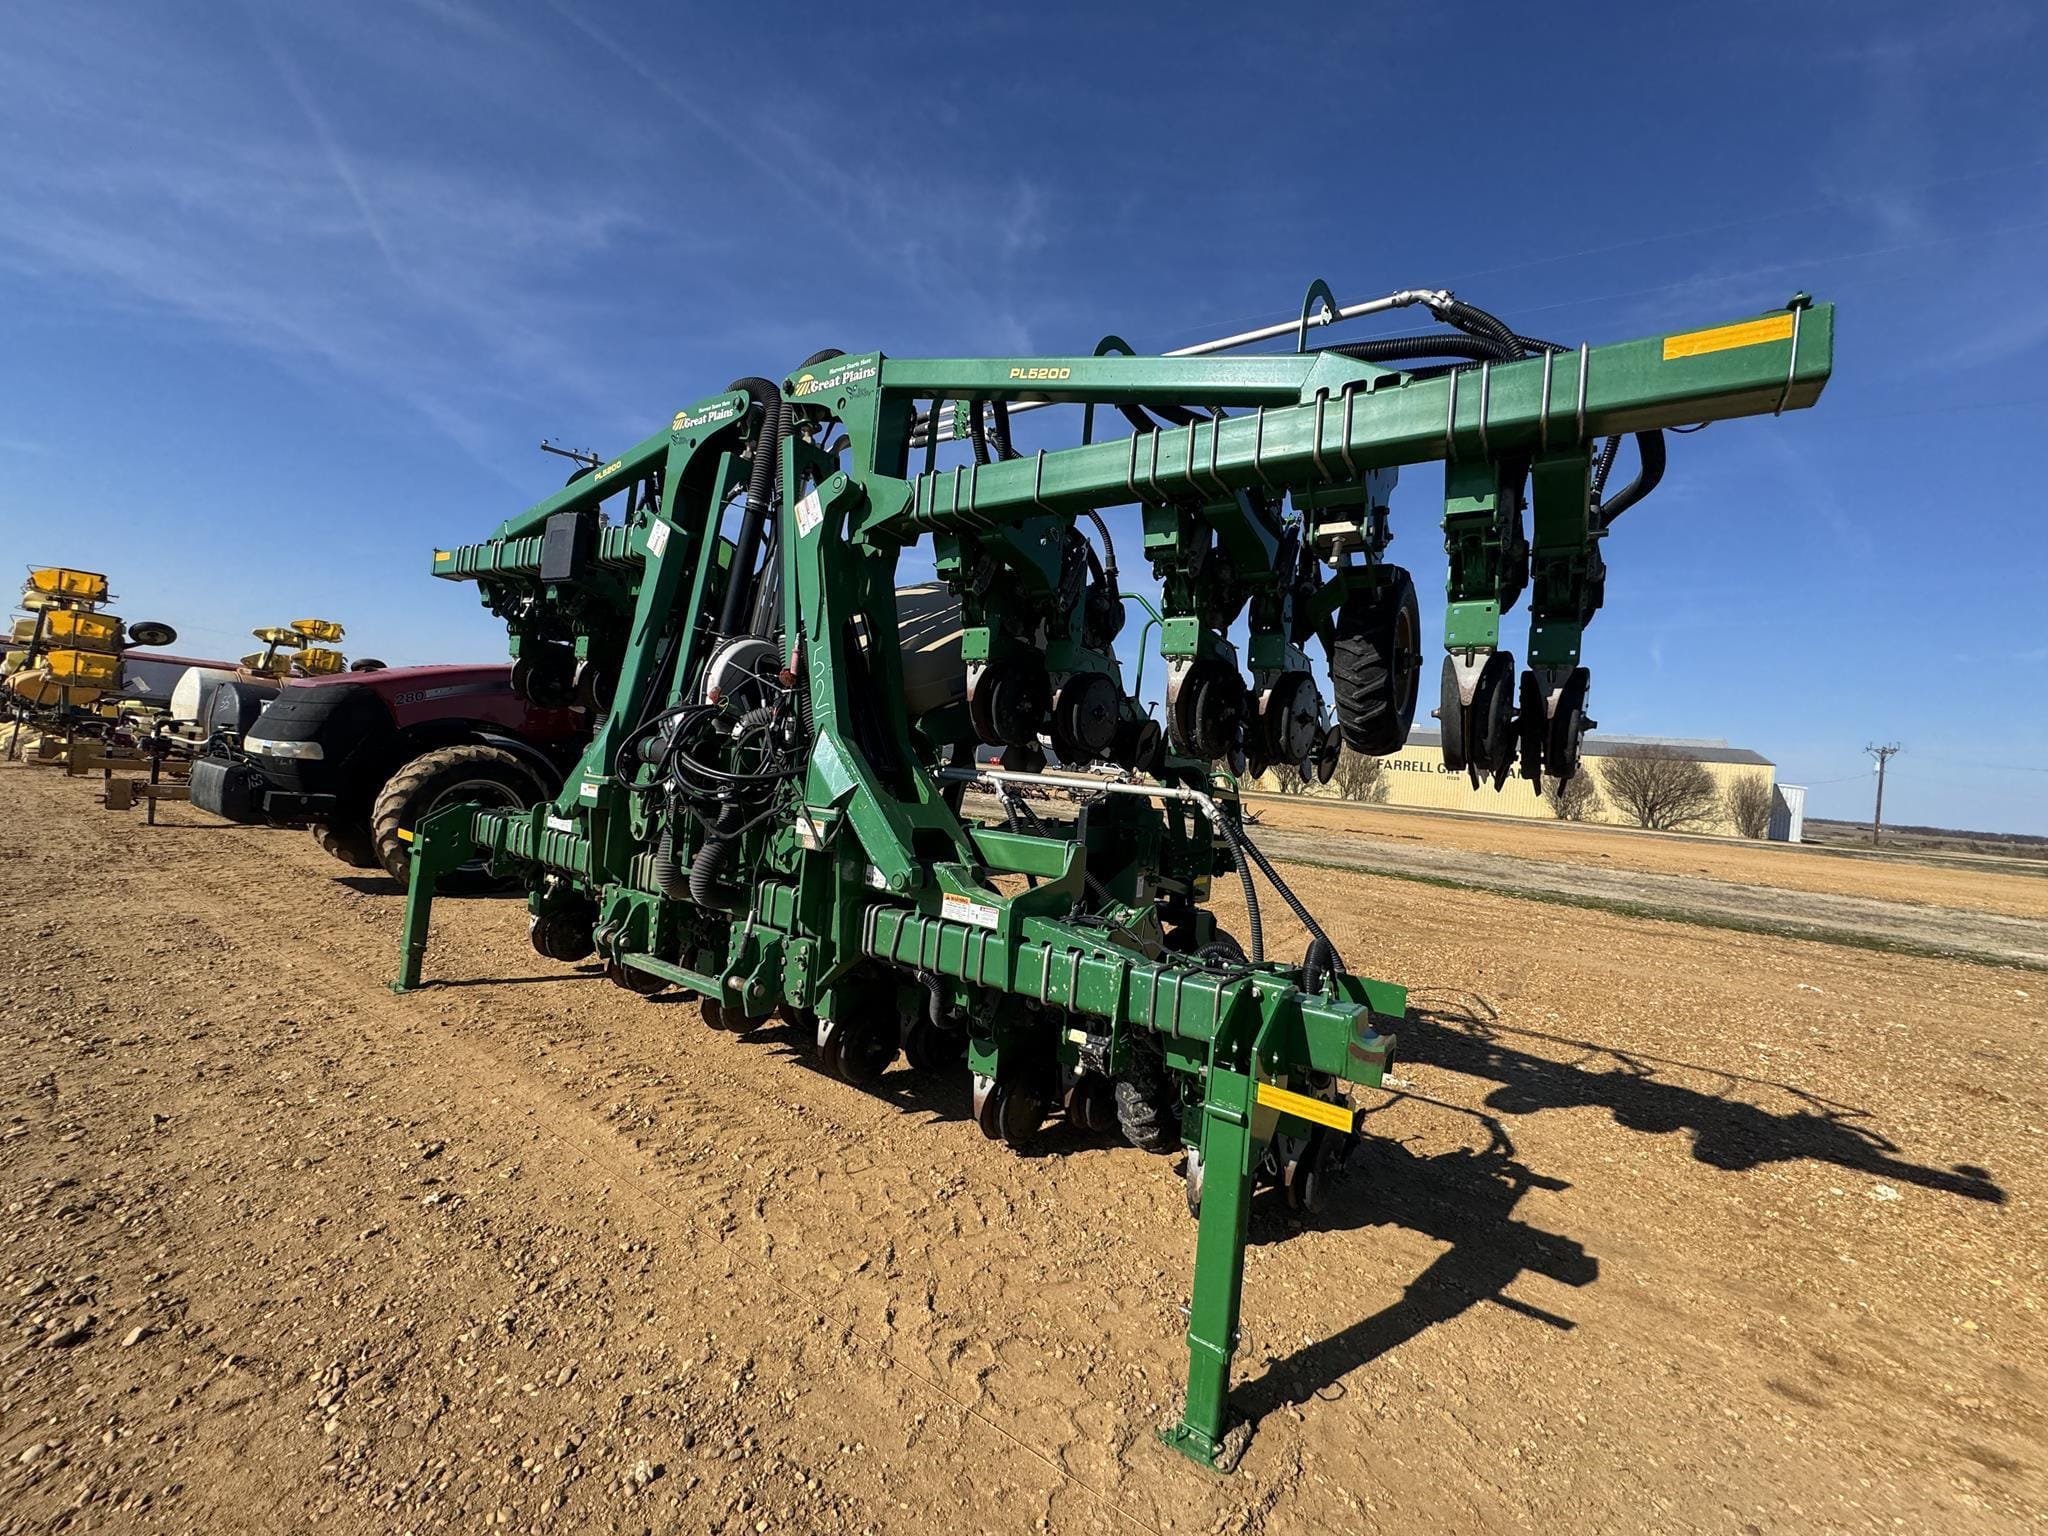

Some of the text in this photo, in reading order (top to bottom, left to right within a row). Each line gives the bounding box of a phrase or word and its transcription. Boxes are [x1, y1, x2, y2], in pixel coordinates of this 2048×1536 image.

[810, 376, 841, 394] Great
[841, 367, 876, 385] Plains
[1009, 367, 1071, 379] PL5200
[684, 408, 734, 429] Great Plains
[813, 645, 830, 710] 52
[395, 691, 425, 706] 280
[1376, 759, 1434, 773] FARRELL
